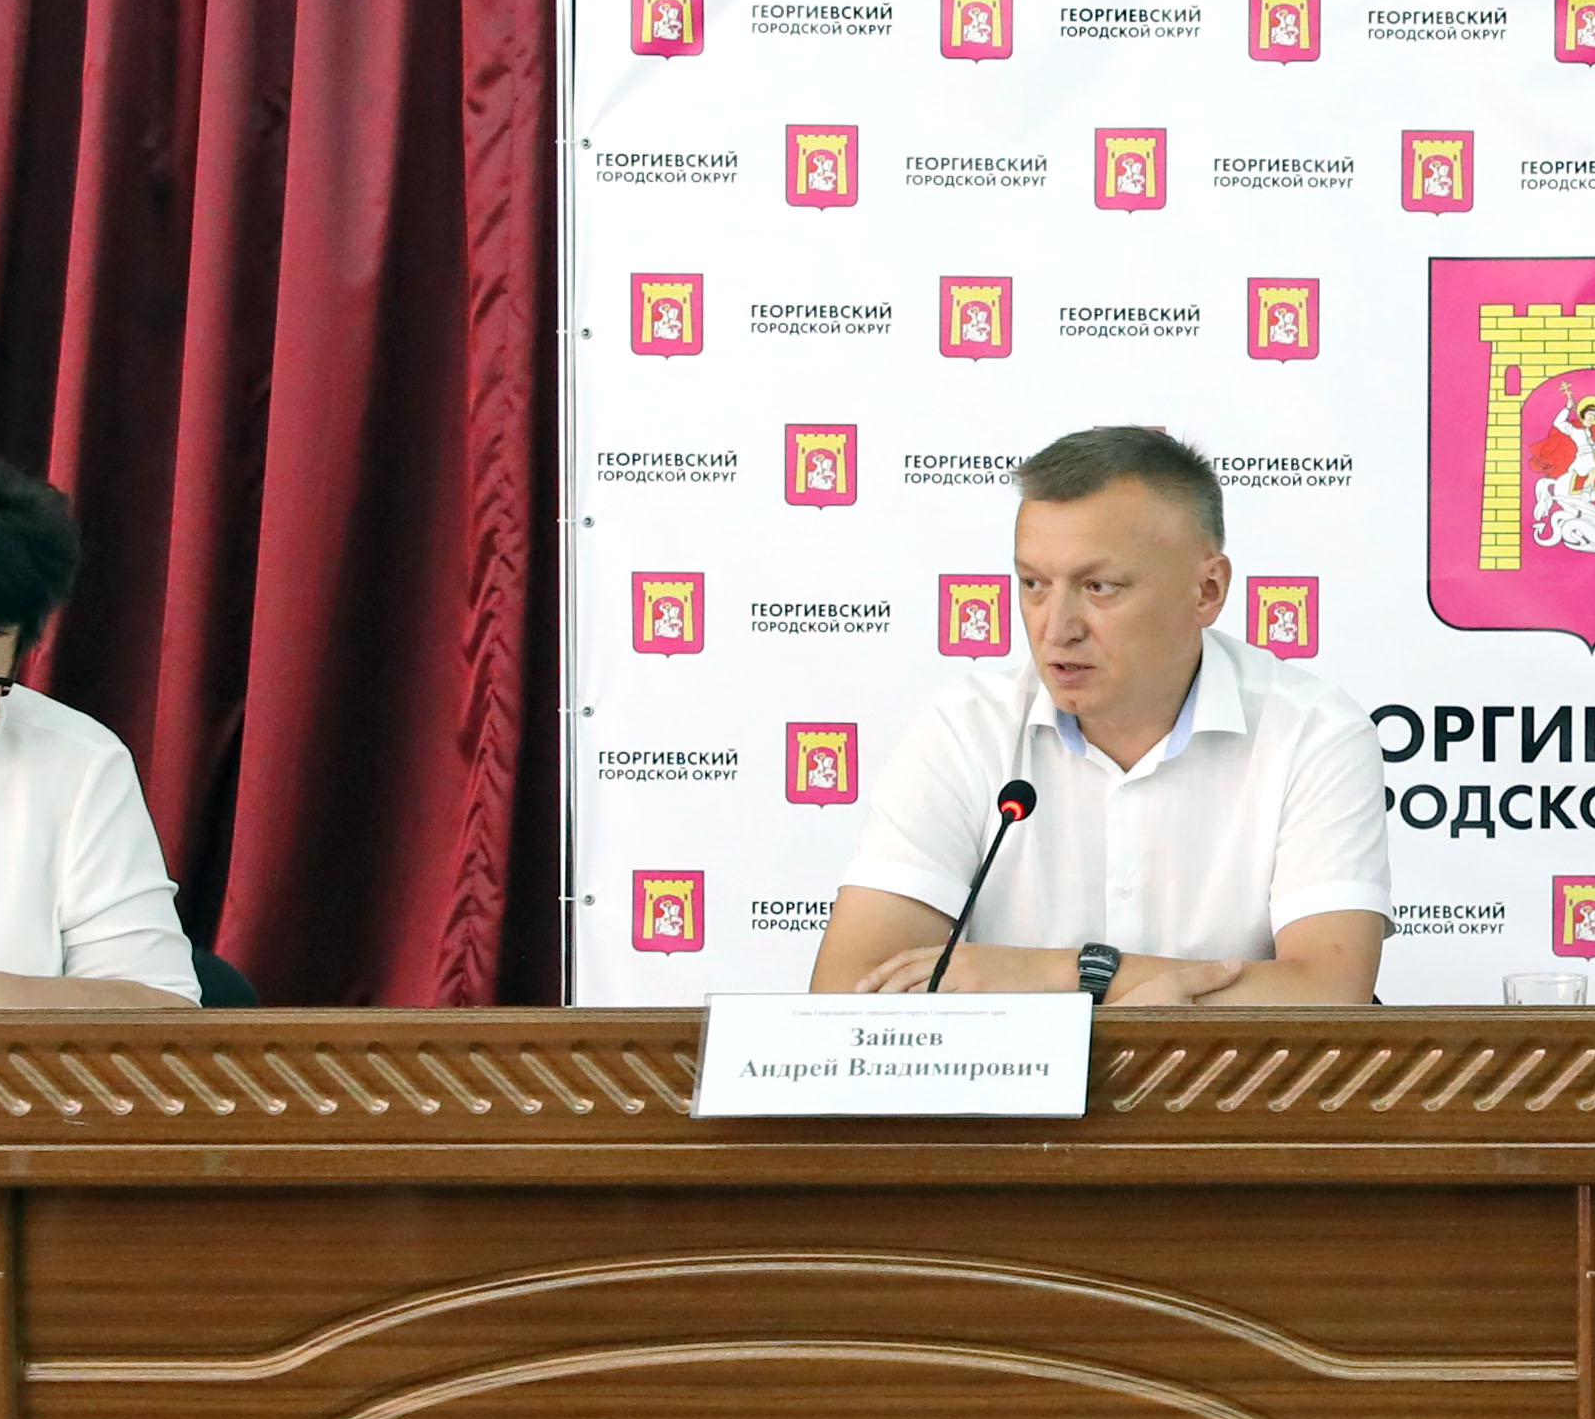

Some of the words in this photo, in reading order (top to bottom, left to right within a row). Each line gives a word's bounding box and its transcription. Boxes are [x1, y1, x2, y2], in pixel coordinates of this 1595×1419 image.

[752, 3, 892, 20] ГЕОРГИЕВСКИЙ
[1060, 6, 1201, 23] ГЕОРГИЕВСКИЙ
[1368, 8, 1507, 25] ГЕОРГИЕВСКИЙ
[752, 22, 841, 36] ГОРОДСКОЙ
[846, 24, 891, 35] ОКРУГ
[1060, 25, 1149, 38] ГОРОДСКОЙ
[1154, 27, 1199, 37] ОКРУГ
[1368, 27, 1457, 41] ГОРОДСКОЙ
[1462, 29, 1506, 40] ОКРУГ
[596, 151, 737, 168] ГЕОРГИЕВСКИЙ
[906, 155, 1047, 172] ГЕОРГИЕВСКИЙ
[1214, 156, 1354, 173] ГЕОРГИЕВСКИЙ
[596, 170, 685, 184] ГОРОДСКОЙ
[690, 172, 736, 183] ОКРУГ
[906, 174, 995, 187] ГОРОДСКОЙ
[1000, 176, 1045, 186] ОКРУГ
[1214, 176, 1303, 188] ГОРОДСКОЙ
[1308, 178, 1352, 187] ОКРУГ
[751, 302, 892, 319] ГЕОРГИЕВСКИЙ
[1060, 305, 1200, 322] ГЕОРГИЕВСКИЙ
[751, 321, 840, 335] ГОРОДСКОЙ
[845, 323, 890, 334] ОКРУГ
[1060, 324, 1149, 338] ГОРОДСКОЙ
[1154, 326, 1198, 337] ОКРУГ
[598, 450, 737, 467] ГЕОРГИЕВСКИЙ
[905, 455, 1023, 470] ГЕОРГИЕВСК
[1213, 455, 1353, 472] ГЕОРГИЕВСКИЙ
[598, 469, 687, 483] ГОРОДСКОЙ
[692, 471, 735, 482] ОКРУГ
[905, 471, 994, 487] ГОРОДСКОЙ
[1219, 473, 1302, 488] ОРОДСКОЙ
[1306, 475, 1351, 487] ОКРУГ
[751, 601, 891, 618] ГЕОРГИЕВСКИЙ
[751, 620, 840, 634] ГОРОДСКОЙ
[845, 622, 889, 633] ОКРУГ
[599, 749, 738, 766] ГЕОРГИЕВСКИЙ
[599, 767, 688, 782] ГОРОДСКОЙ
[693, 769, 737, 781] ОКРУГ
[752, 901, 835, 915] ГЕОРГИЕ
[1393, 902, 1505, 919] РГИЕВСКИЙ
[752, 919, 828, 932] ГОРОДСКО
[1395, 921, 1454, 936] ОДСКОЙ
[1458, 923, 1504, 935] ОКРУГ
[852, 1028, 943, 1047] Зайцев
[740, 1059, 837, 1082] Андрей
[848, 1058, 1049, 1081] Владимирович
